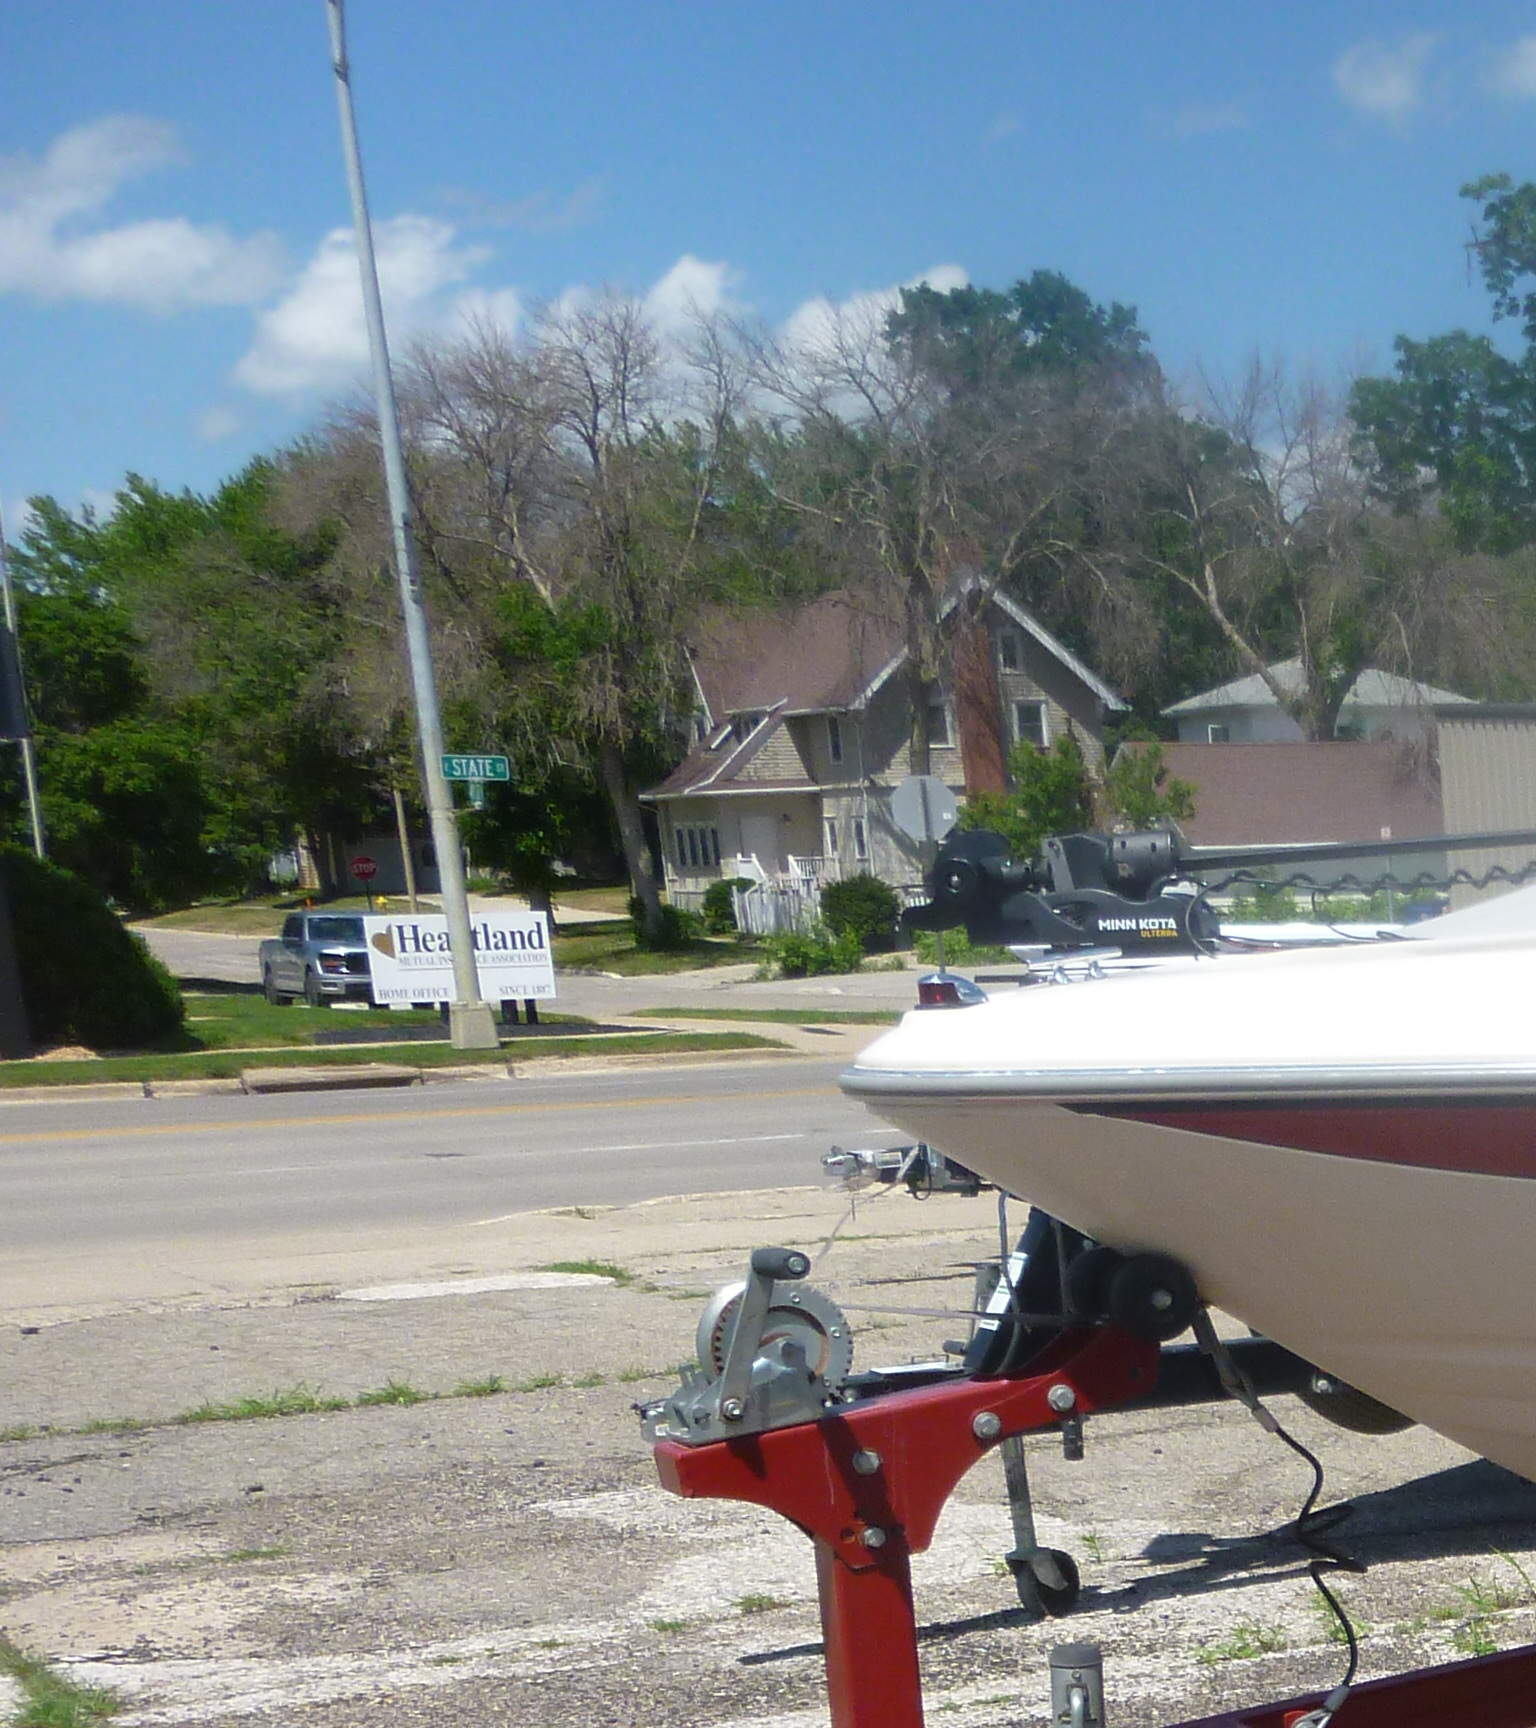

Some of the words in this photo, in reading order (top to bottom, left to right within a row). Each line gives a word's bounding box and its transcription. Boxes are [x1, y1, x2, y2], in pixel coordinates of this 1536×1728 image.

[452, 759, 494, 777] STATE
[1098, 919, 1136, 931] MINN
[1139, 917, 1177, 929] KOTA
[395, 922, 545, 953] Heatland
[380, 989, 408, 999] HOME
[413, 988, 449, 998] OFFICE
